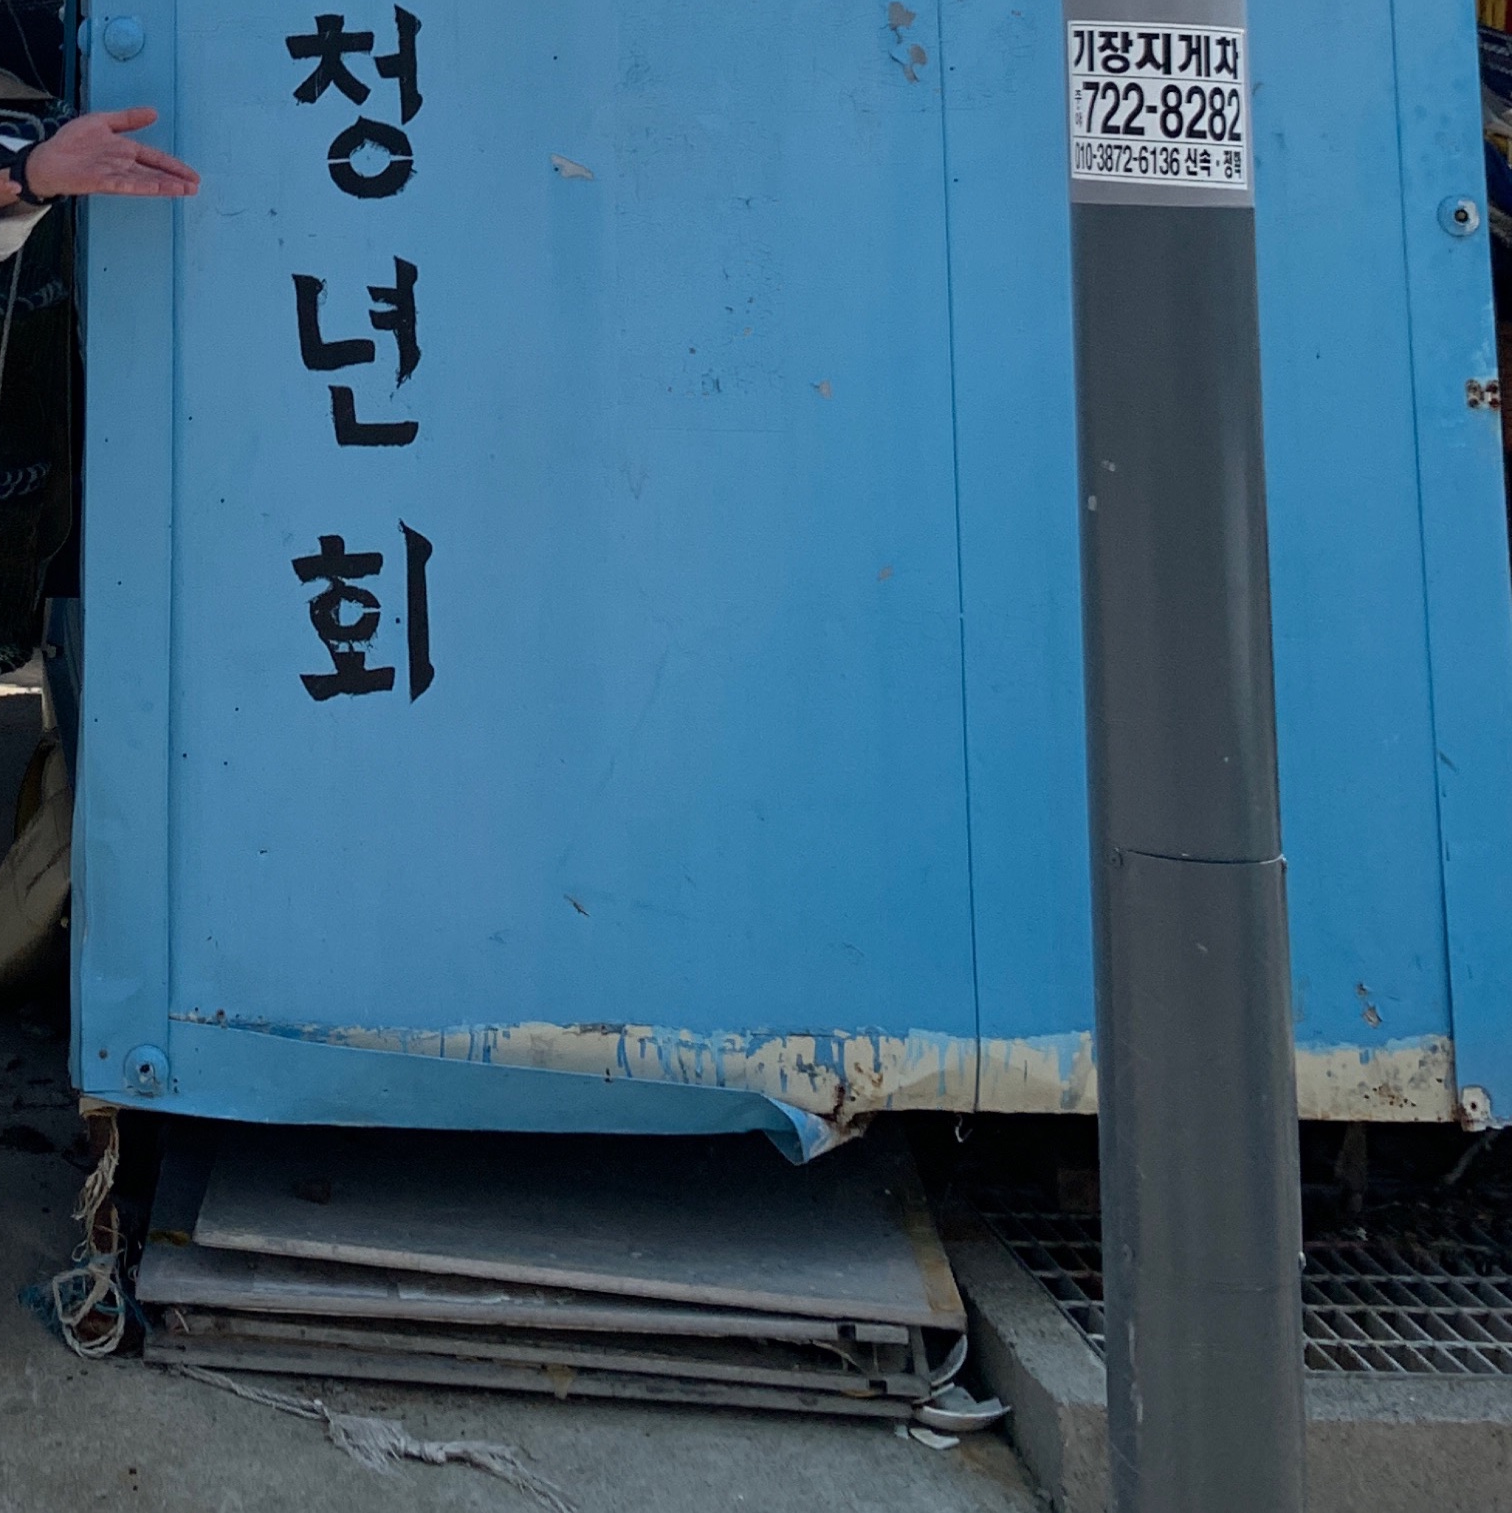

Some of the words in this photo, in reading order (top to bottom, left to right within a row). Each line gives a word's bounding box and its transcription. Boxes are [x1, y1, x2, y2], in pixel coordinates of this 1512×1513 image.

[1073, 29, 1240, 80] 기장지게차
[1082, 80, 1243, 142] 722-8282
[1075, 141, 1180, 177] 010-3872-6136
